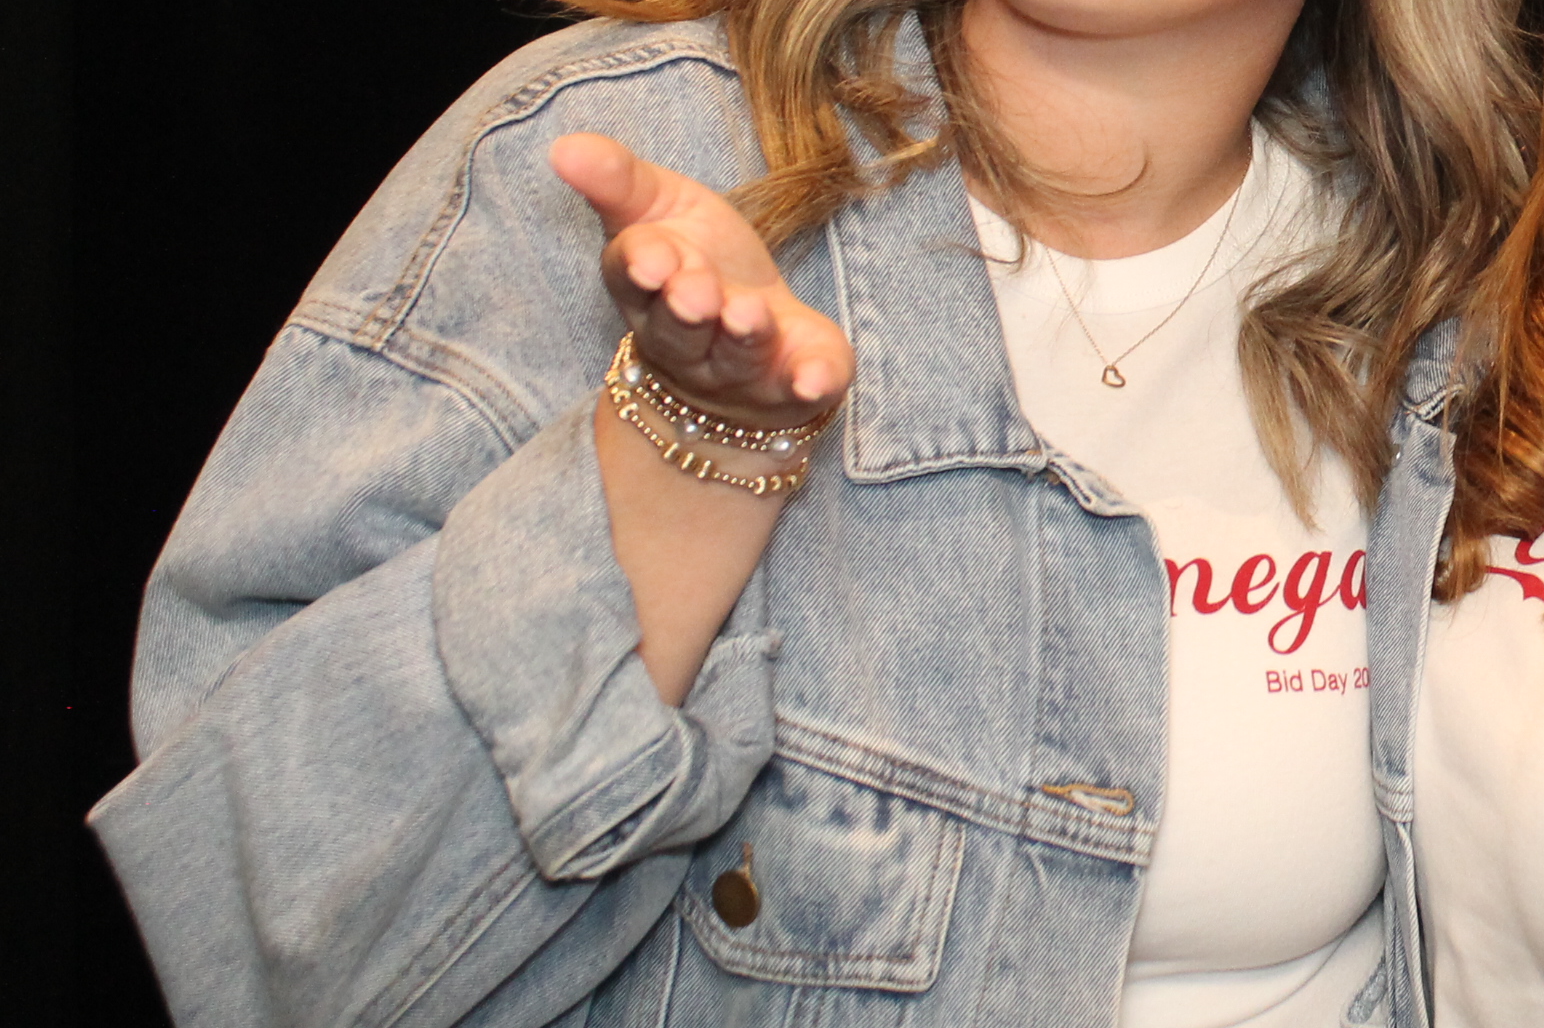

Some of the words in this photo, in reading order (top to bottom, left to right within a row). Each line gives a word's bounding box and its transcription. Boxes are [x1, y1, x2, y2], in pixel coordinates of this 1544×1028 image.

[1265, 669, 1305, 694] Bid
[1311, 668, 1348, 695] Day
[1353, 667, 1370, 689] 20
